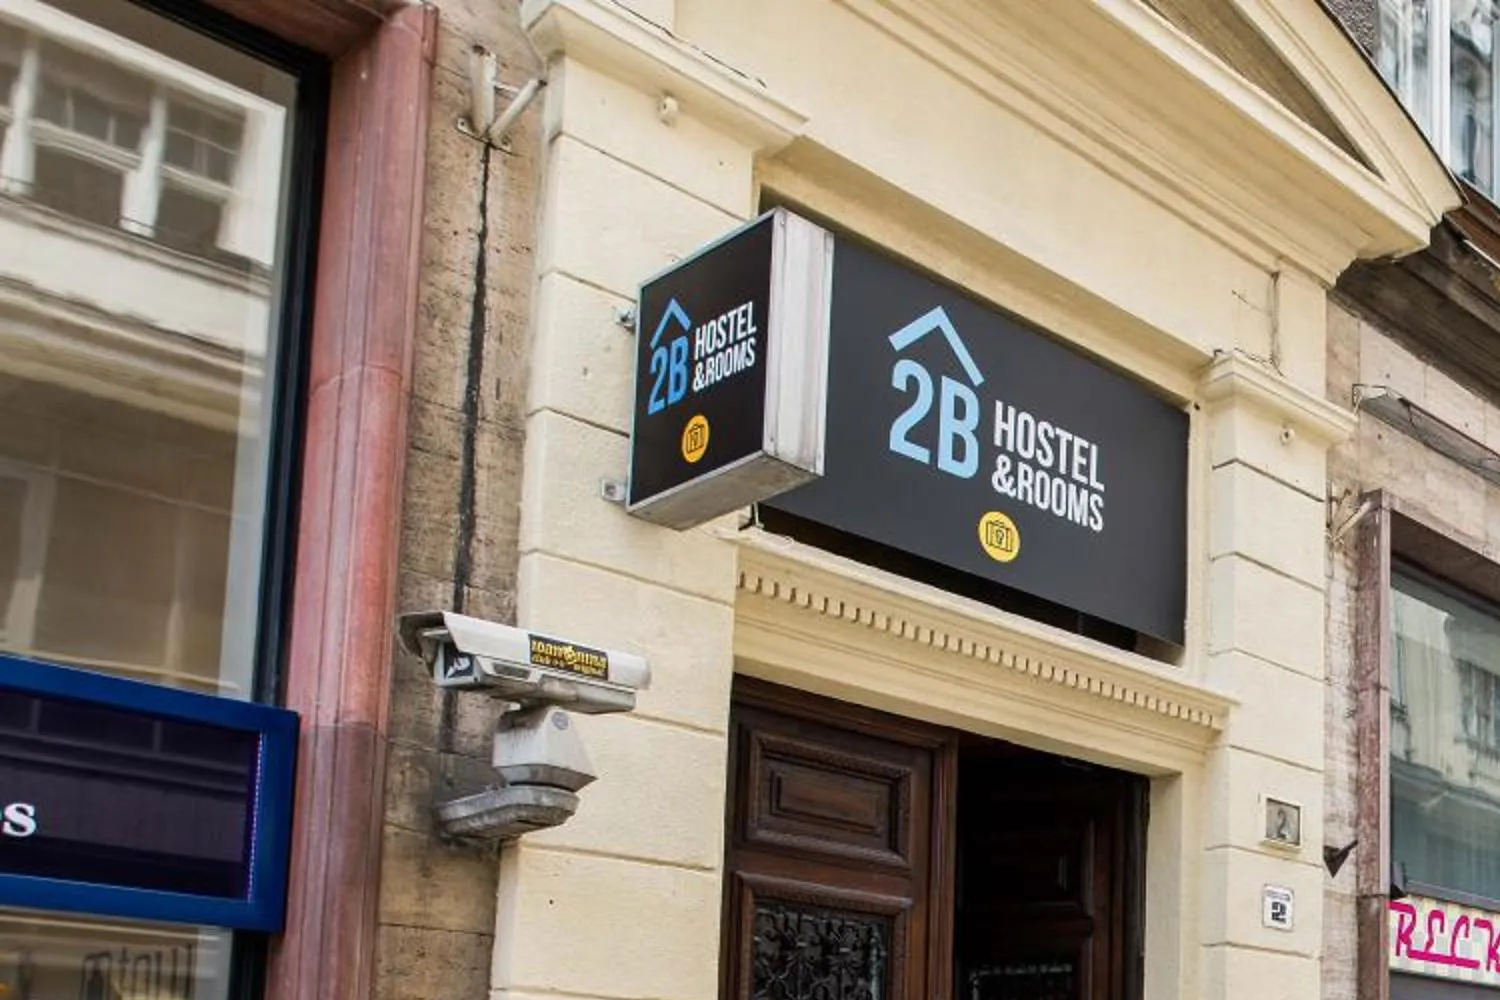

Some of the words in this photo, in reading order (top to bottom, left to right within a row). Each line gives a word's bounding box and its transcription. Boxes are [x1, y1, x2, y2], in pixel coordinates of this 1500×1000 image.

[692, 335, 756, 394] &ROOMS
[694, 300, 757, 362] HOSTEL
[647, 333, 690, 416] 2B
[888, 358, 982, 479] 2B
[994, 400, 1105, 492] HOSTEL
[990, 456, 1104, 533] &ROOMS
[1271, 902, 1287, 924] 2
